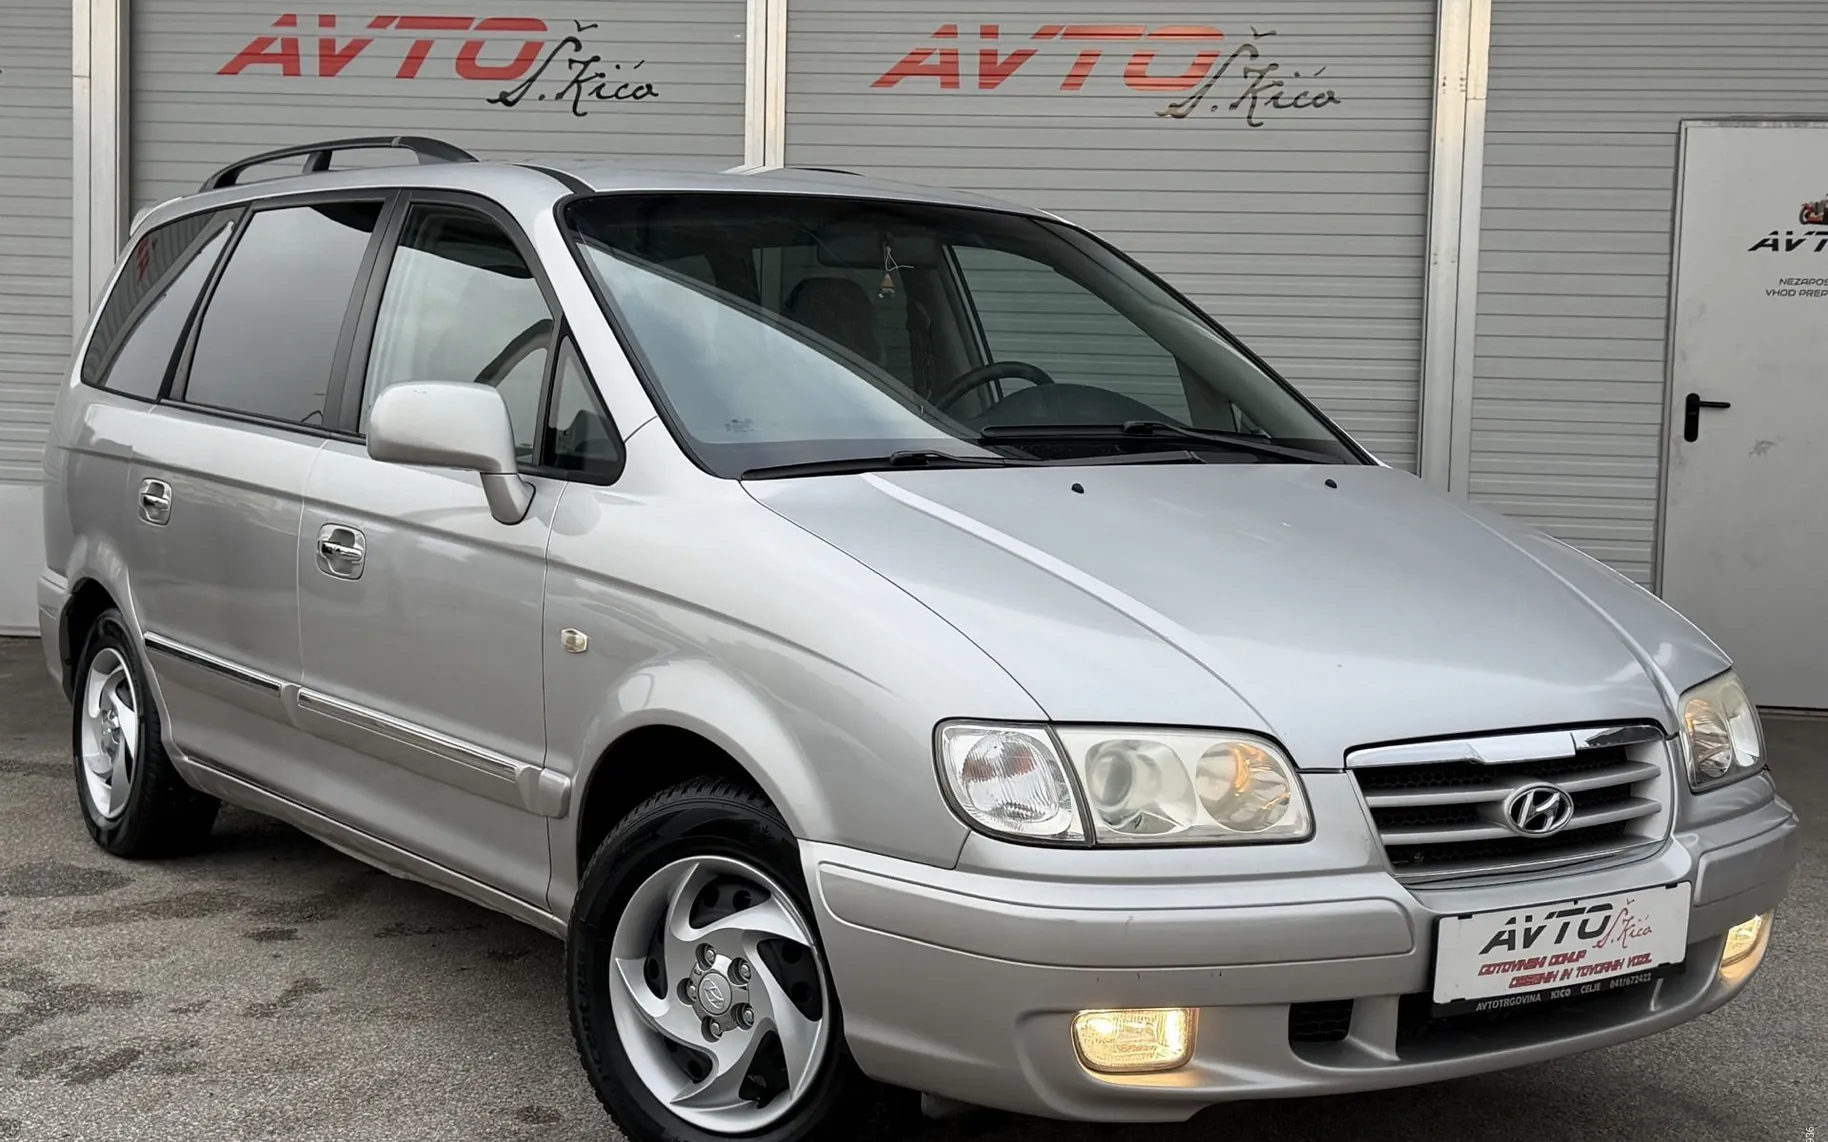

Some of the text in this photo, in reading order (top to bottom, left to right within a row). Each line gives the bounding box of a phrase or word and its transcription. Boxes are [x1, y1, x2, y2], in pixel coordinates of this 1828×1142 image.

[216, 13, 547, 80] AVTO
[869, 24, 1225, 91] AVTO
[1765, 289, 1797, 297] VHOD
[1478, 903, 1613, 955] AVTO
[1475, 992, 1542, 1012] AVTOTRGOVINA
[1580, 981, 1602, 995] CELJE
